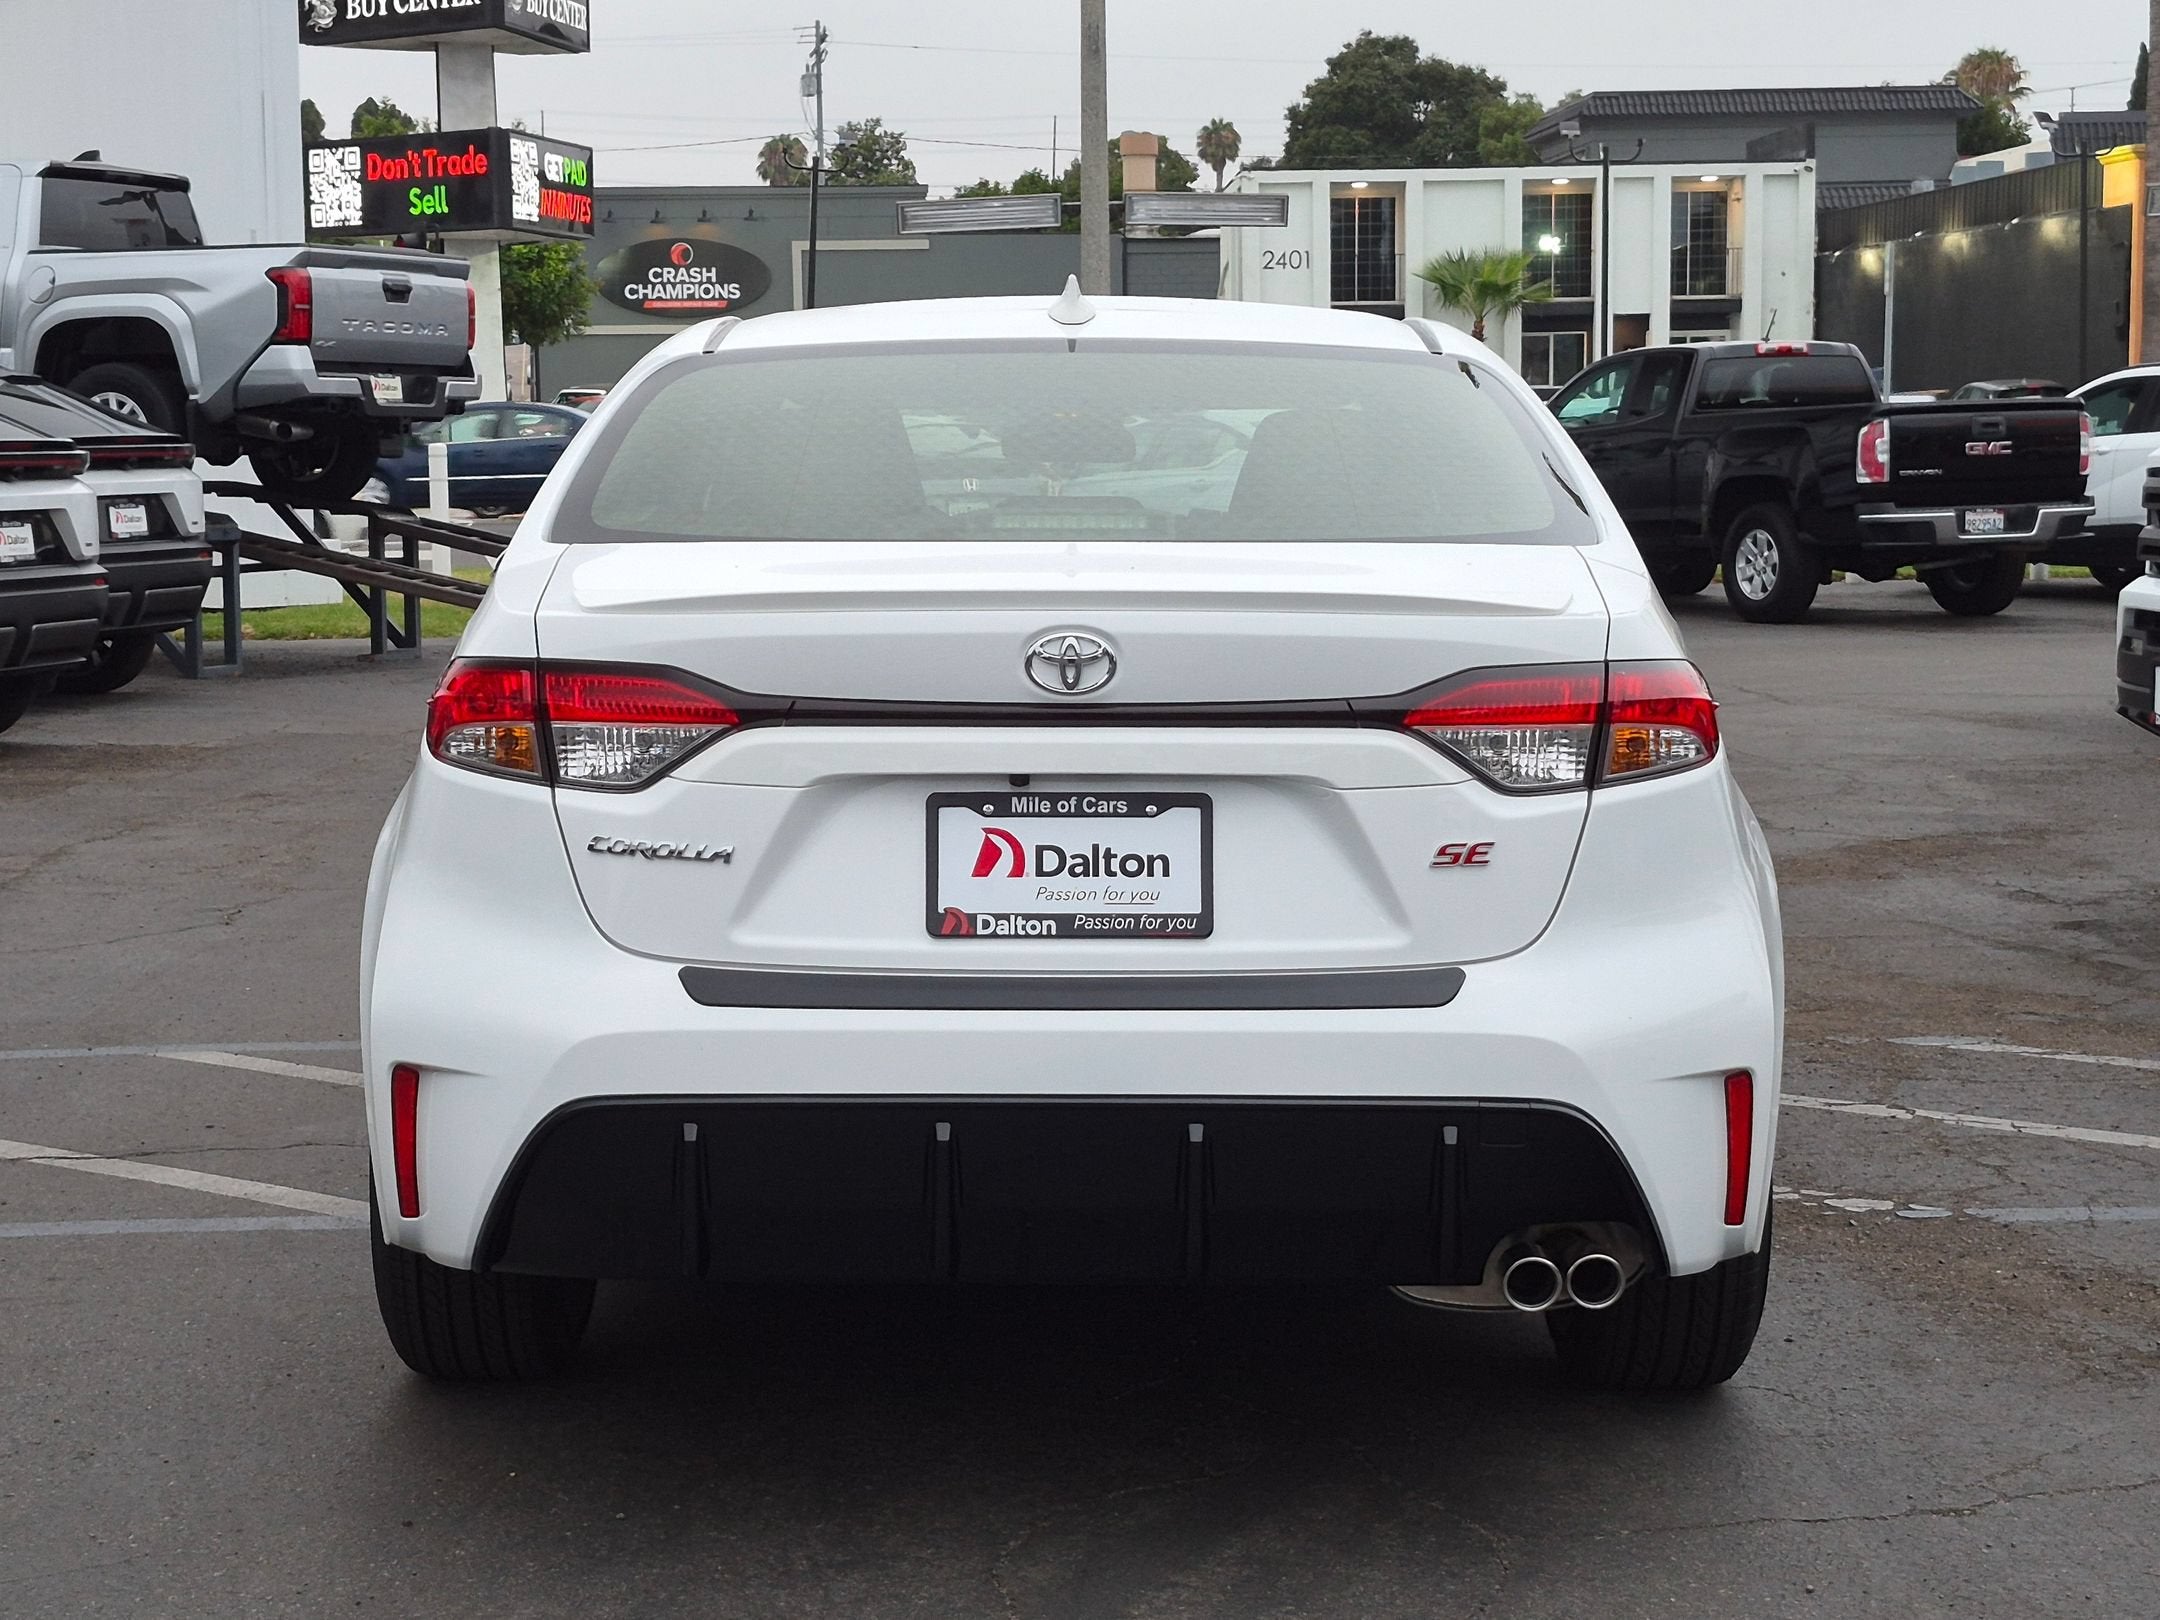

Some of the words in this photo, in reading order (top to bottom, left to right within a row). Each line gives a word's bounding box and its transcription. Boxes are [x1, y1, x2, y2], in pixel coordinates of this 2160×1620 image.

[345, 0, 388, 20] BUY
[550, 0, 587, 31] CENTER
[367, 149, 421, 182] Don't
[423, 144, 488, 178] Trade
[544, 152, 564, 183] GET
[564, 156, 587, 187] PAID
[408, 185, 449, 216] Sell
[1262, 250, 1310, 270] 2401
[648, 267, 717, 283] CRASH
[624, 283, 742, 300] CHAMPIONS
[342, 318, 449, 337] TACOMA
[1965, 441, 2013, 455] GMC
[1010, 796, 1051, 814] Mile
[1057, 796, 1077, 814] of
[1082, 797, 1129, 814] Cars
[587, 835, 734, 865] COROLLA
[1035, 843, 1171, 878] Dalton
[1429, 841, 1495, 868] SE
[1035, 886, 1098, 901] Passion
[1102, 886, 1127, 901] for
[1129, 889, 1161, 905] you
[976, 914, 1057, 936] Dalton
[1073, 914, 1135, 930] Passion
[1138, 914, 1162, 930] for
[1165, 918, 1197, 932] you
